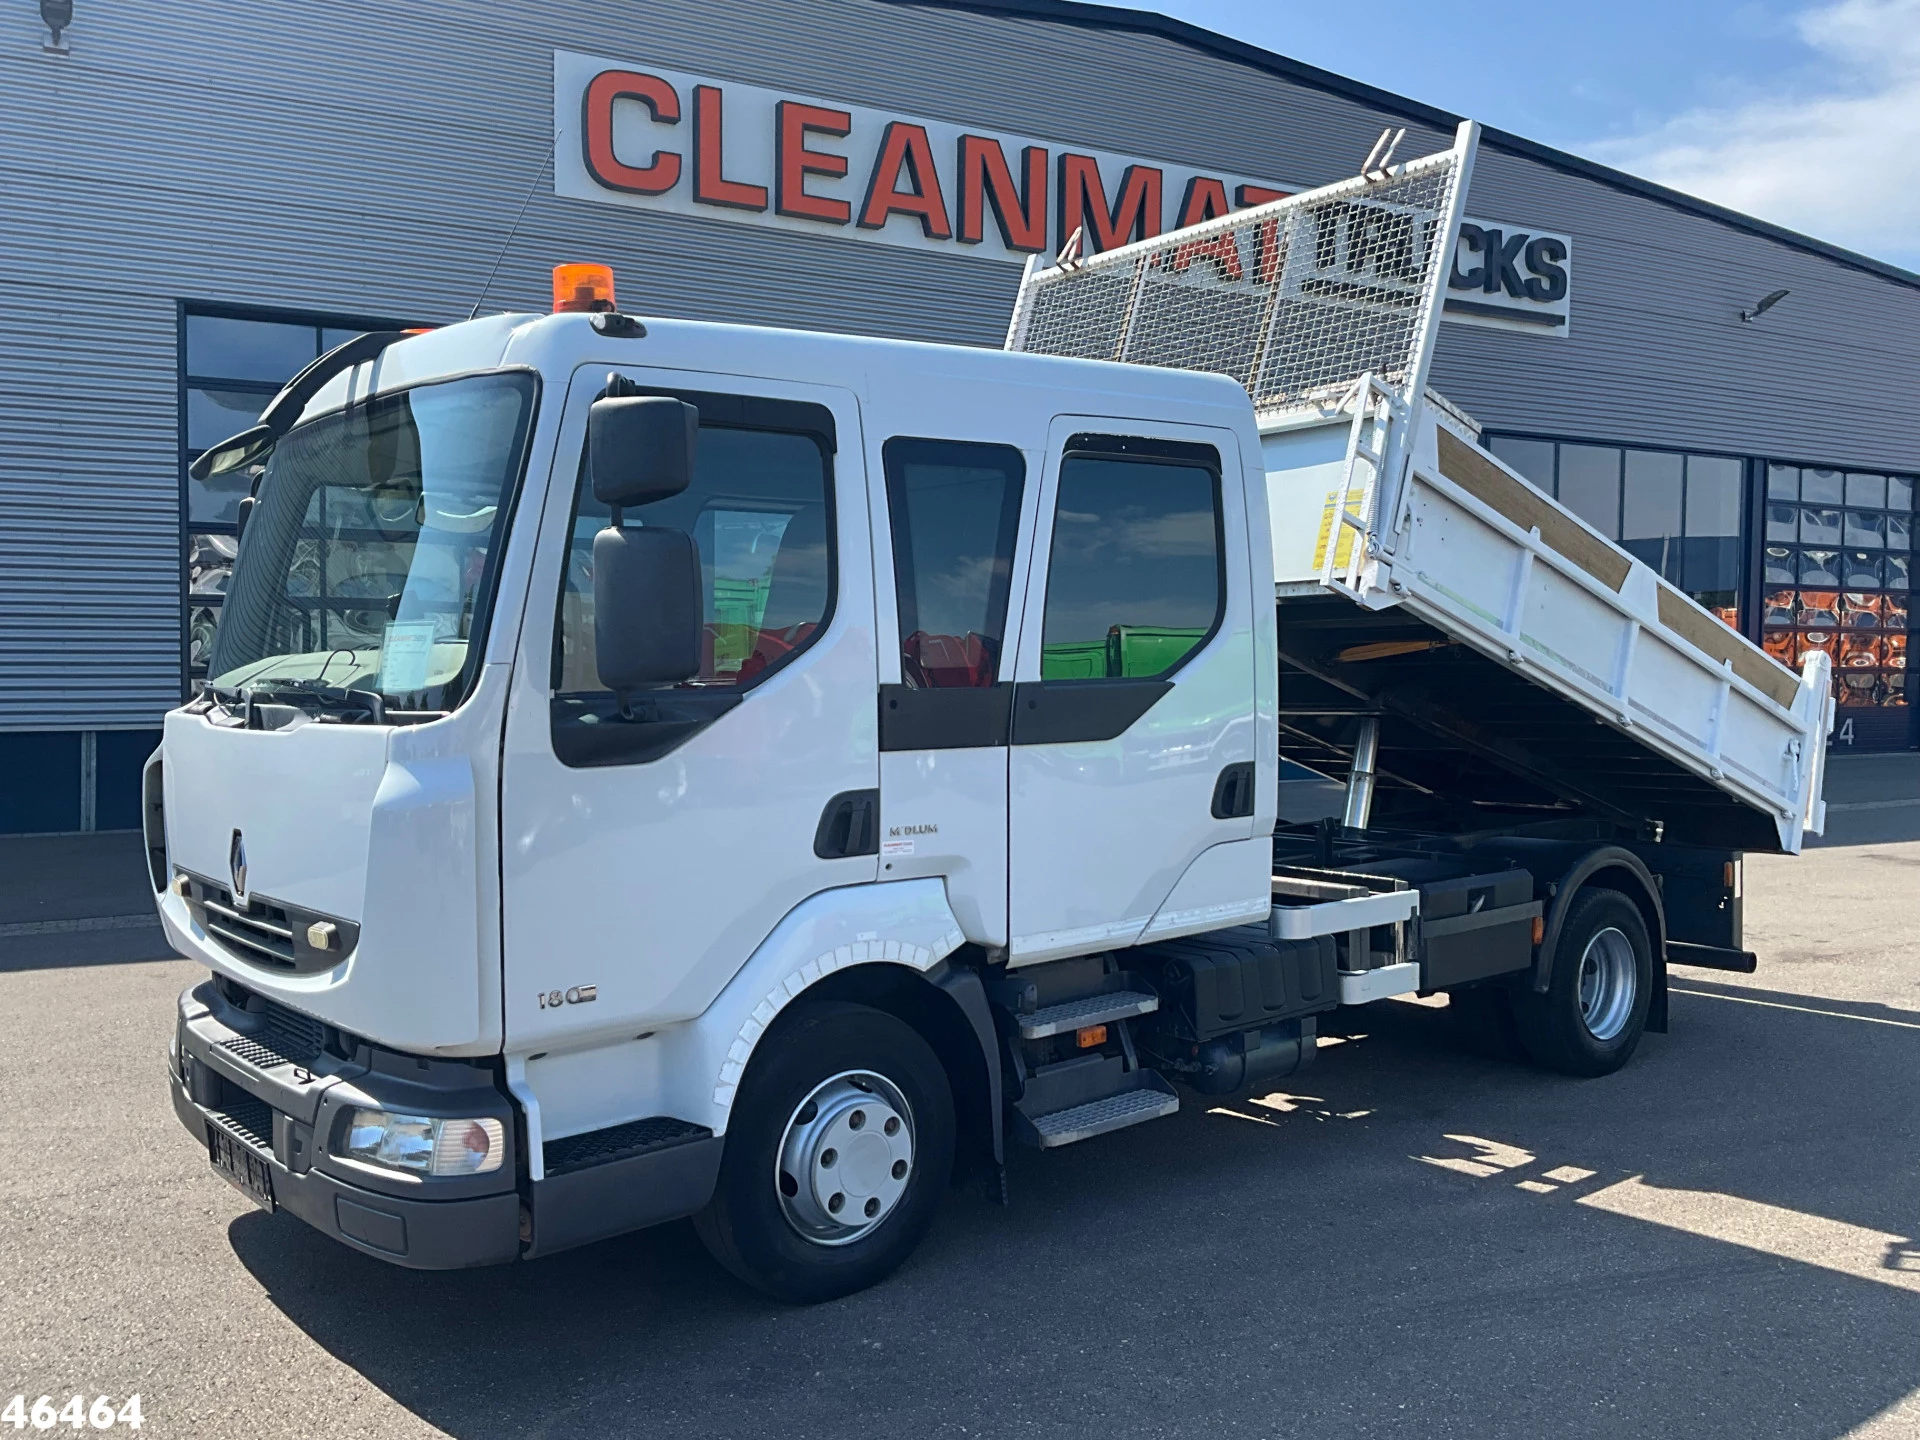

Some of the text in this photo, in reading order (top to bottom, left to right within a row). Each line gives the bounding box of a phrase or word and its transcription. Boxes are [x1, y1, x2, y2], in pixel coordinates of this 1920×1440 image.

[582, 69, 1568, 303] CLEANMAT TRUCKS
[1826, 717, 1855, 746] 4
[889, 823, 939, 837] MDLUM
[537, 986, 583, 1010] 180
